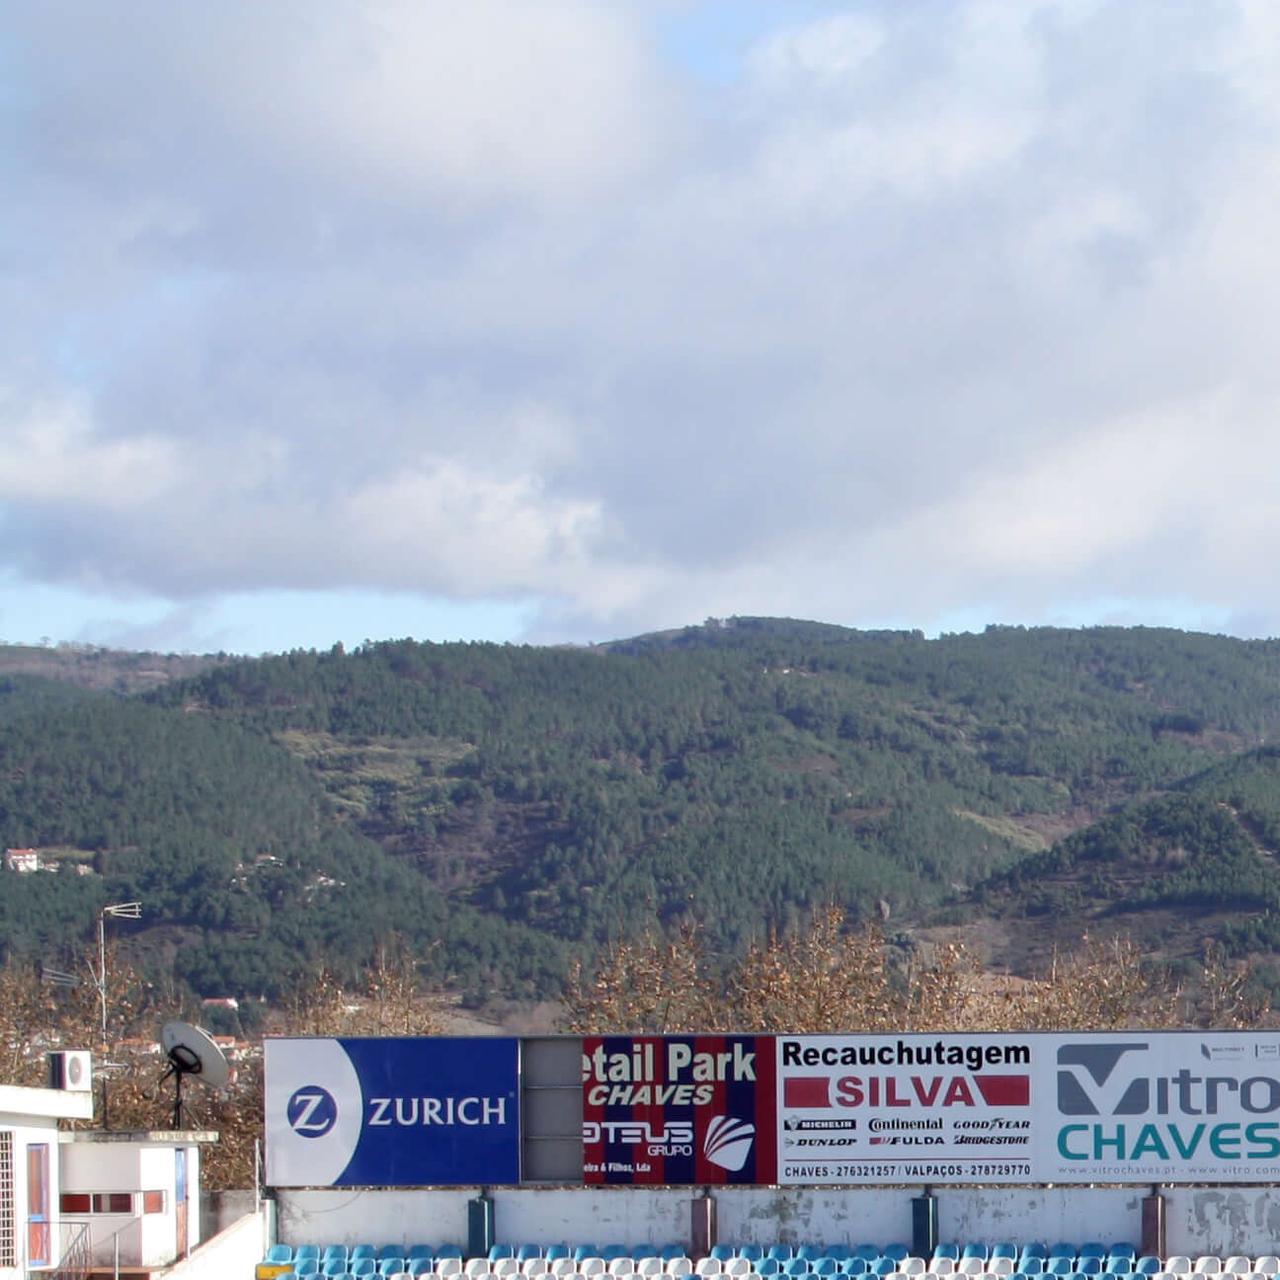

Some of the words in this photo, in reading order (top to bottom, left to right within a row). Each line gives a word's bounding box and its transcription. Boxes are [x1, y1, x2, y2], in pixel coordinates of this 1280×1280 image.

[668, 1043, 757, 1082] Park
[782, 1041, 1030, 1071] Recauchutagem
[587, 1084, 715, 1106] CHAVES
[835, 1076, 976, 1107] SILVA
[368, 1096, 506, 1126] ZURICH
[868, 1118, 943, 1133] Continental
[647, 1145, 693, 1156] GRUPO
[797, 1138, 857, 1147] DUNLOP
[889, 1137, 945, 1145] FULDA
